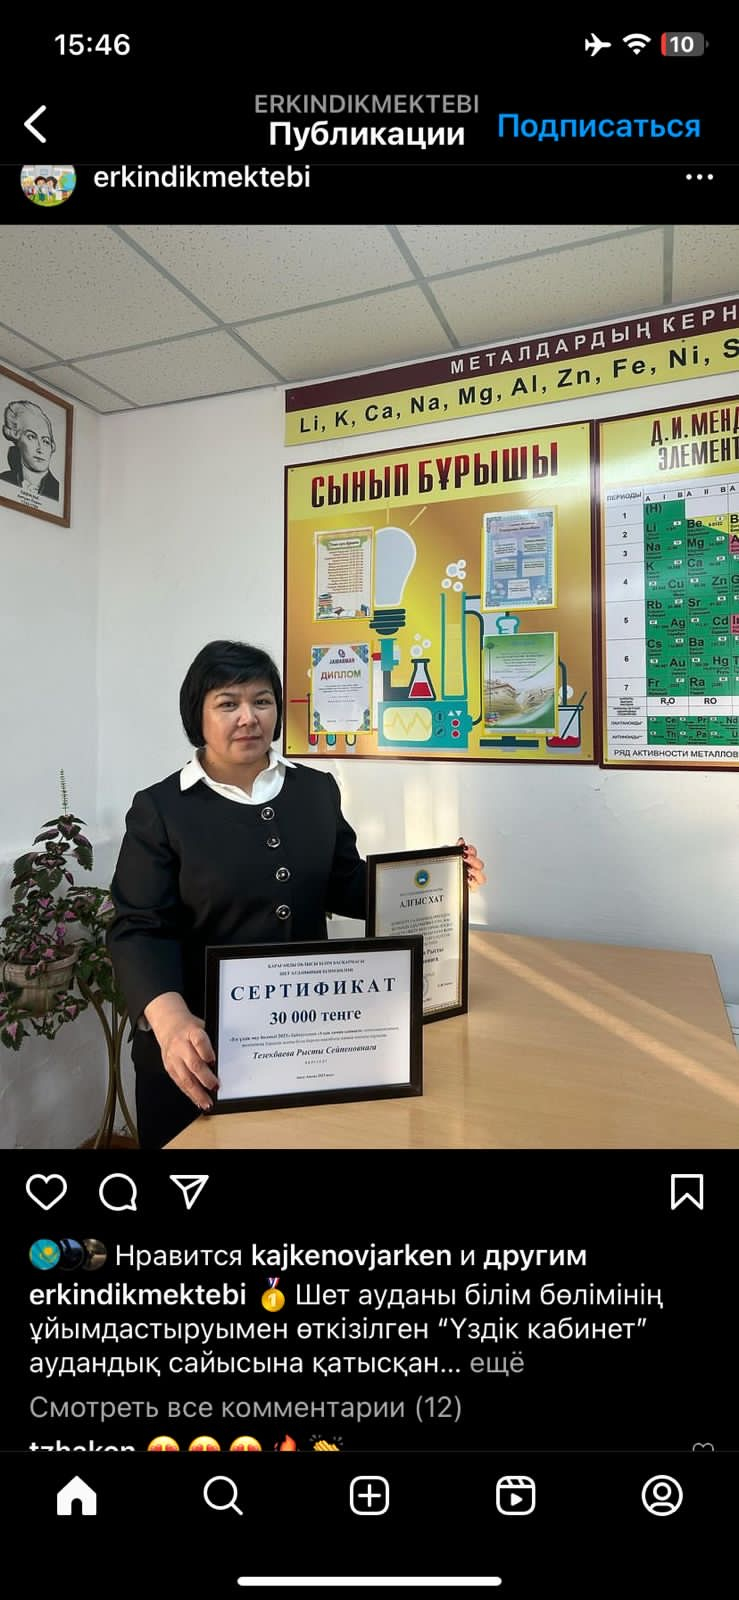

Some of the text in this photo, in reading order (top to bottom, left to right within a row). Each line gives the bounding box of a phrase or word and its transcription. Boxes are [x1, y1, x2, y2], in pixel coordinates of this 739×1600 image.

[450, 304, 738, 375] МЕТАЛДАРДЫҢ КЕРН
[299, 417, 326, 433] Li,
[335, 410, 356, 428] K,
[365, 404, 401, 421] Ca,
[410, 395, 448, 414] Na,
[458, 385, 501, 405] Mg,
[511, 377, 547, 396] Al,
[557, 368, 601, 388] Zn,
[613, 357, 656, 378] Fe,
[669, 345, 710, 368] Ni,
[311, 441, 559, 508] СЫНЫП БҰРЫШЫ
[645, 503, 662, 514] (H)
[687, 519, 703, 529] Be
[646, 542, 661, 552] Na
[687, 539, 705, 549] Mg
[646, 561, 654, 571] K
[711, 576, 727, 586] Zn
[646, 600, 662, 609] Rb
[687, 598, 701, 608] Sr
[670, 617, 686, 628] Ag
[712, 616, 729, 626] Cd
[647, 639, 662, 648] Cs
[688, 637, 704, 647] Ba
[624, 655, 630, 663] 6
[669, 658, 686, 667] Au
[712, 655, 729, 667] Hg
[320, 669, 361, 681] ДИПЛОМ
[647, 678, 660, 688] Fr
[689, 677, 705, 687] Ra
[704, 697, 718, 705] RO
[614, 749, 739, 758] РЯД АКТИВНОСТИ МЕТАЛЛОВ
[230, 976, 396, 1001] СЕРТИФИКАТ
[269, 1010, 287, 1025] 30
[291, 1009, 317, 1024] 000
